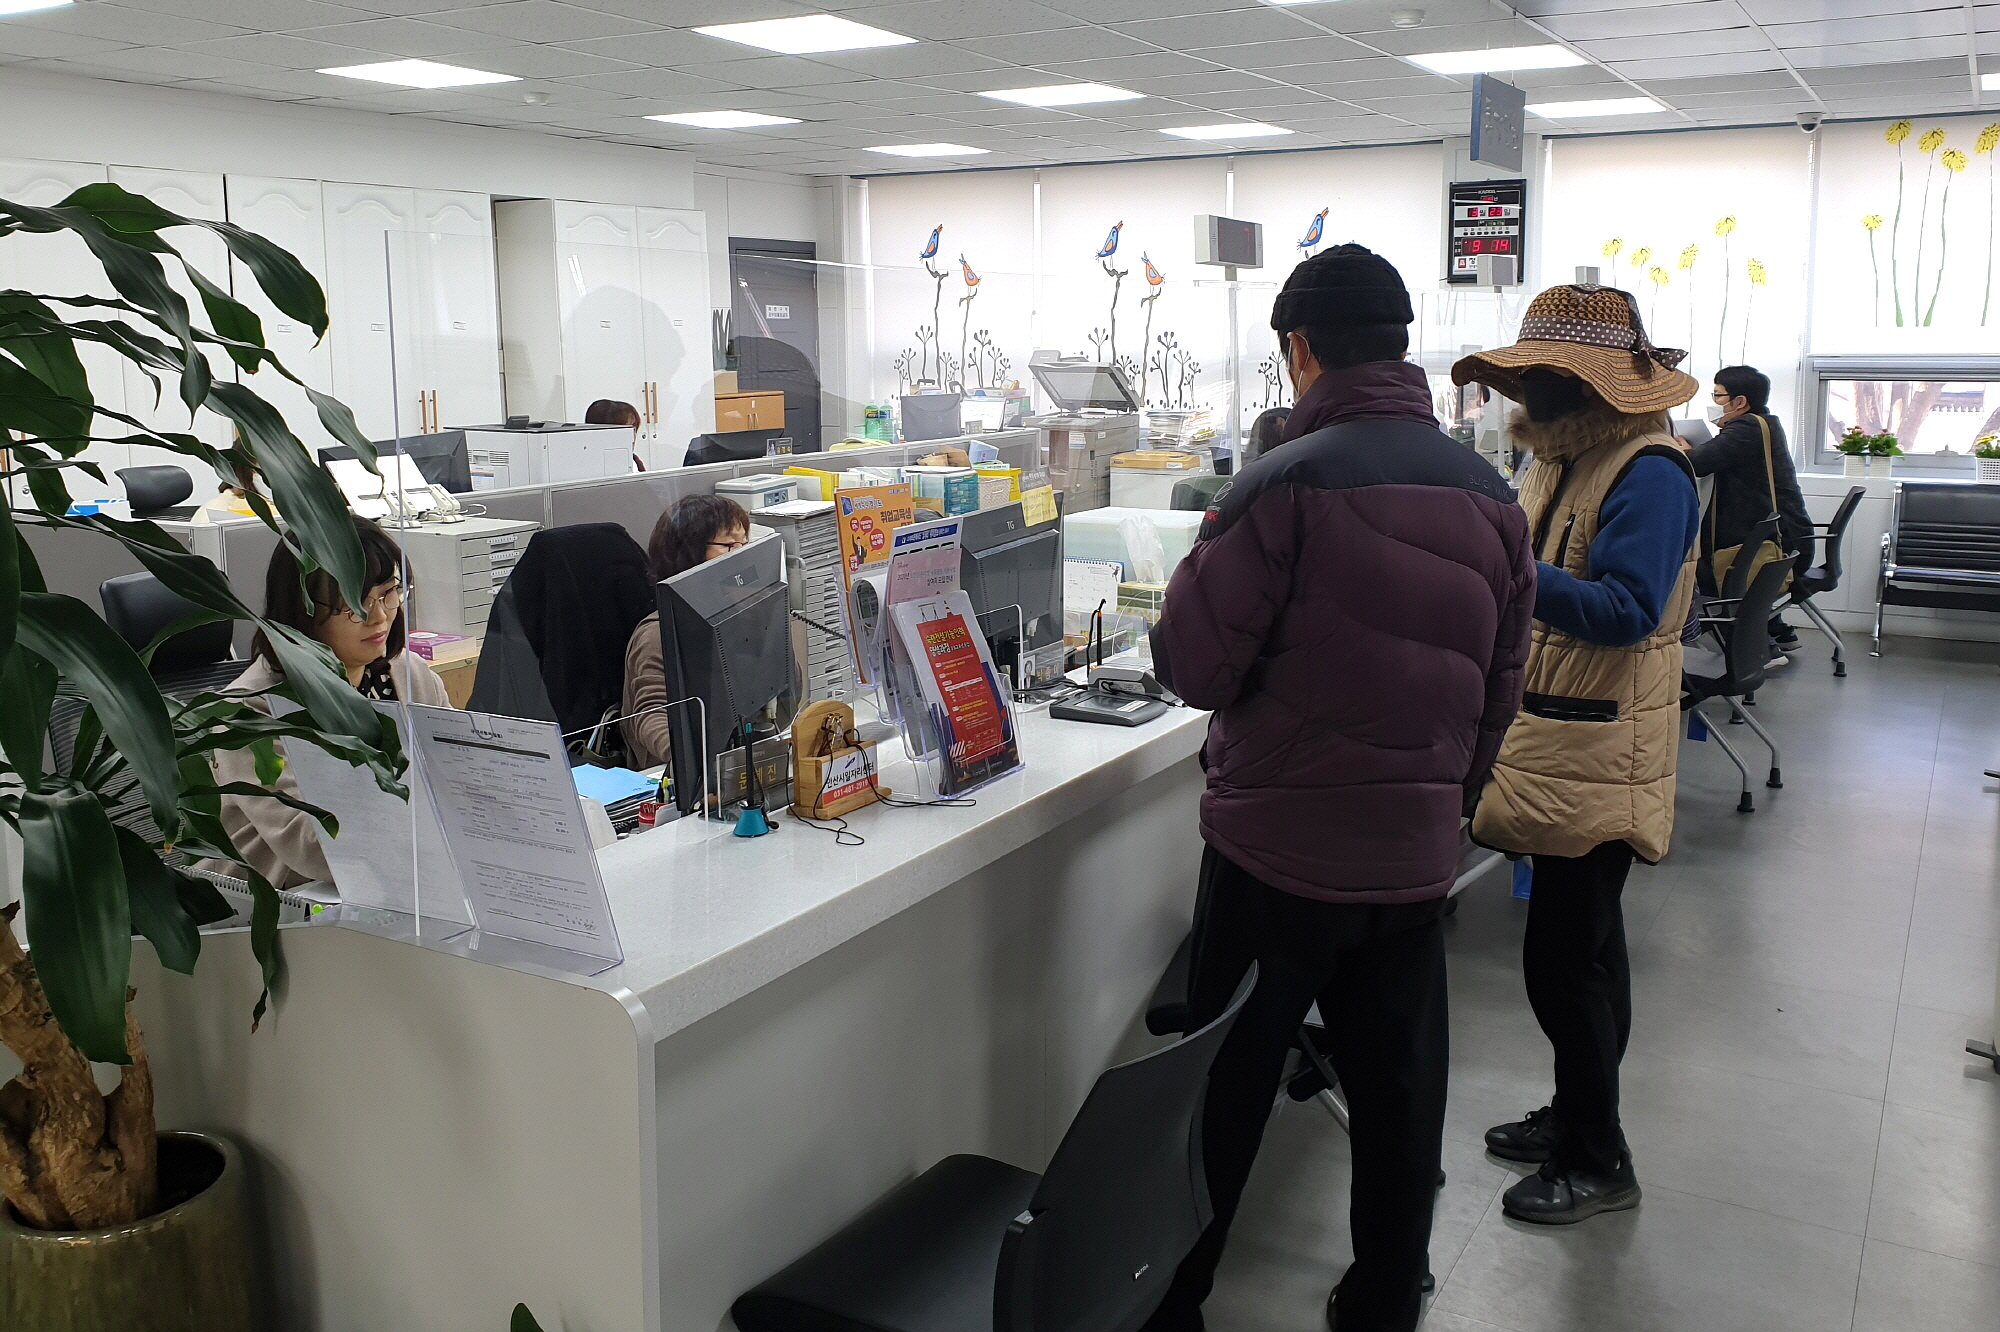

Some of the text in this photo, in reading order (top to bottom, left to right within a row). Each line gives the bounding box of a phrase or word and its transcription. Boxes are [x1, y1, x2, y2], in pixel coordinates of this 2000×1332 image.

[1489, 207, 1502, 217] 23
[1472, 239, 1481, 252] 9
[1494, 239, 1509, 252] 14
[880, 507, 912, 524] 취업교육생
[1006, 520, 1015, 531] TG
[734, 574, 744, 587] TG
